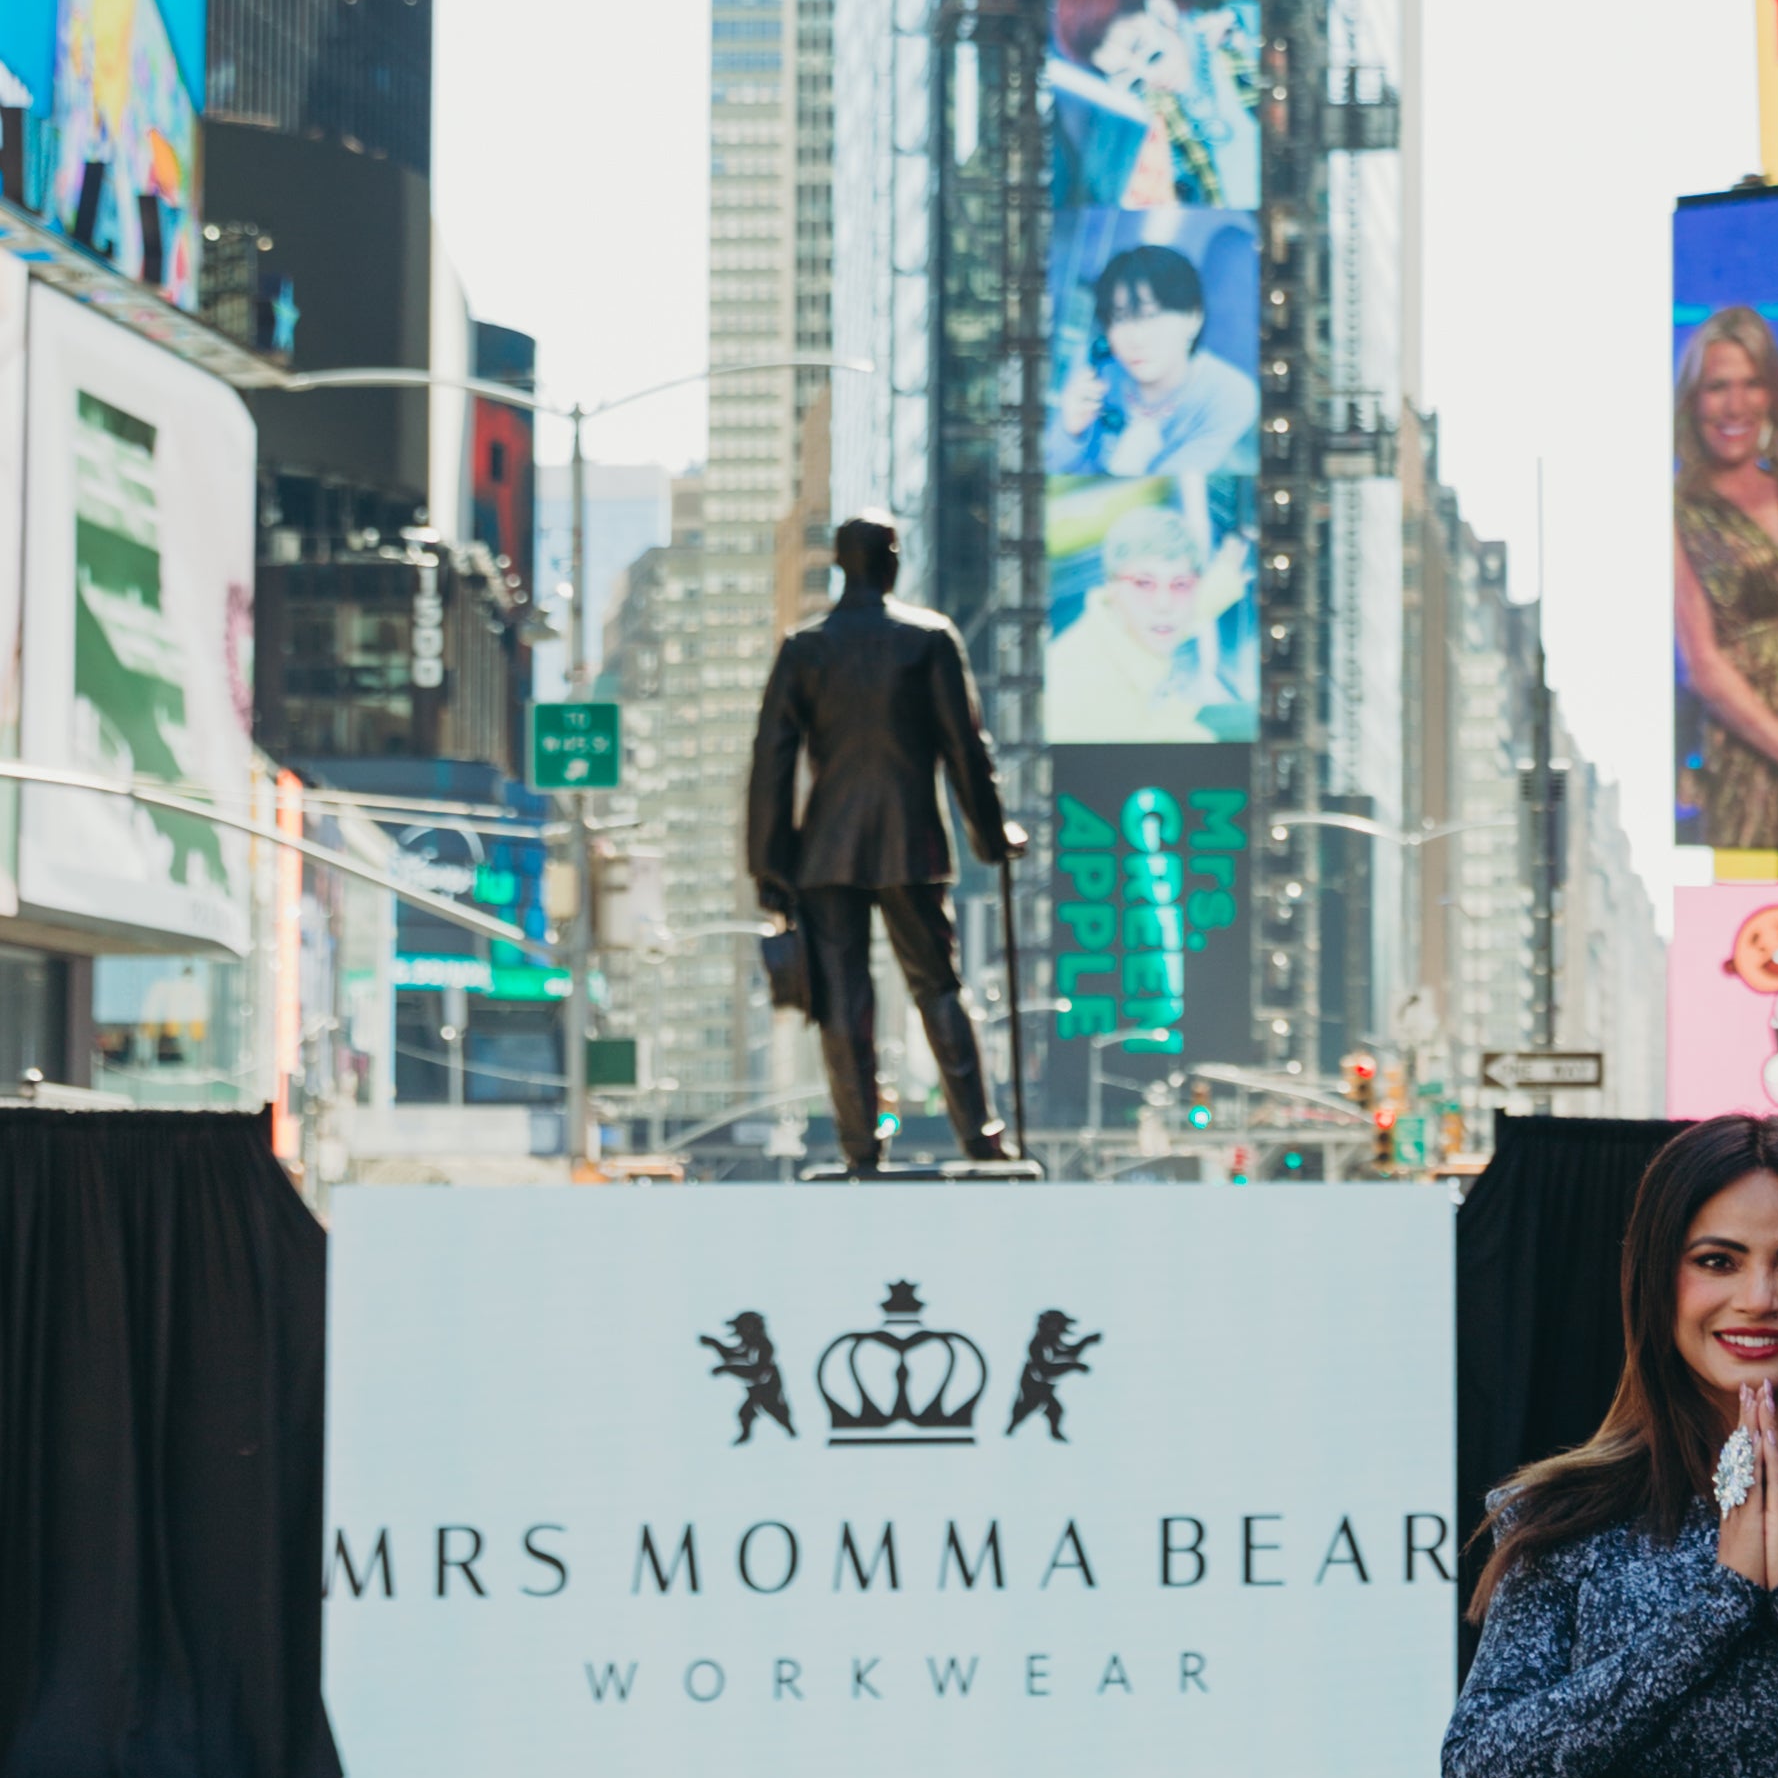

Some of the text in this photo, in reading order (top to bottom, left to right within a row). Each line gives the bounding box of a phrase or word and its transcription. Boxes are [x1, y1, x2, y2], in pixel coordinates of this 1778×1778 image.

[1056, 792, 1119, 1040] APPLE
[1119, 787, 1184, 1055] GREEN
[1186, 788, 1248, 952] Mrs.
[325, 1510, 1456, 1603] MRS MOMMA BEAR
[585, 1650, 1214, 1706] WORKWEAR
